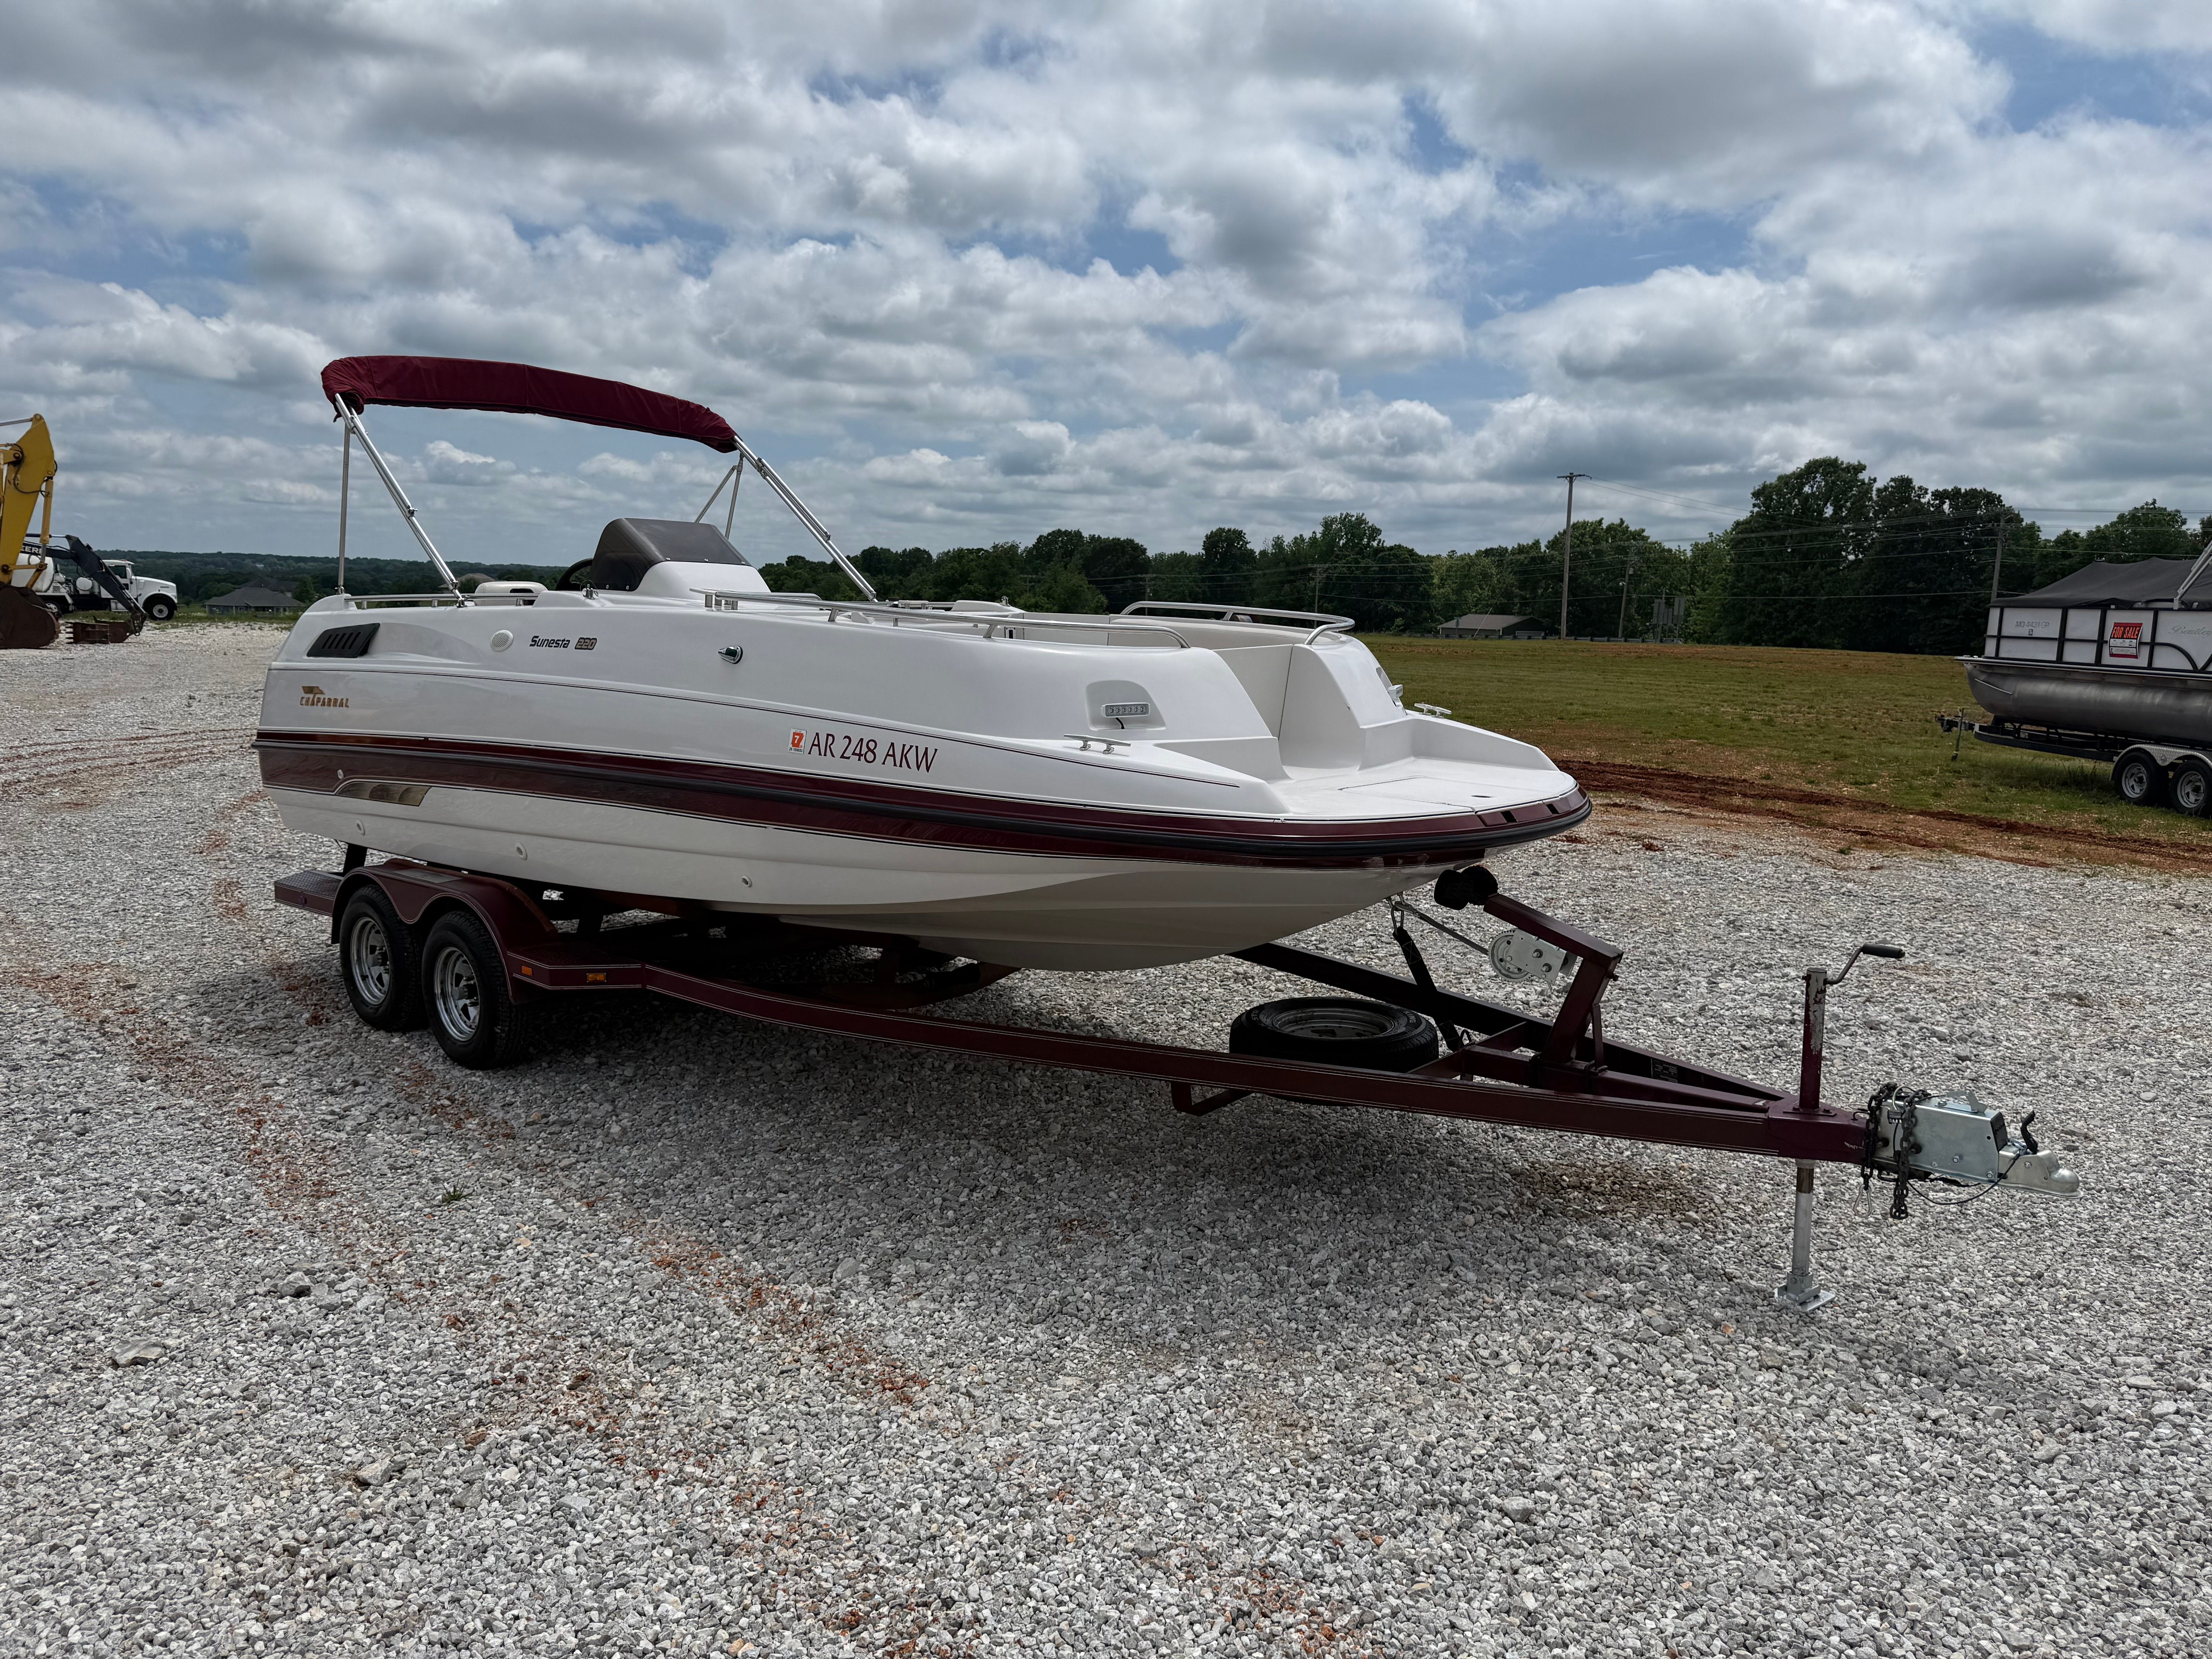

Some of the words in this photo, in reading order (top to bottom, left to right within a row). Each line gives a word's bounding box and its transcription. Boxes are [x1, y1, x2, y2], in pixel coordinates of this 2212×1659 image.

[2111, 626, 2124, 638] FOR
[2124, 627, 2140, 638] SALE
[529, 635, 570, 648] Sunesta
[575, 637, 597, 650] 220
[300, 696, 349, 708] CHAPARRAL
[795, 735, 800, 744] 7
[808, 732, 835, 758] AR
[840, 735, 877, 764] 248
[881, 742, 938, 773] AKW
[1403, 1011, 1416, 1023] KING
